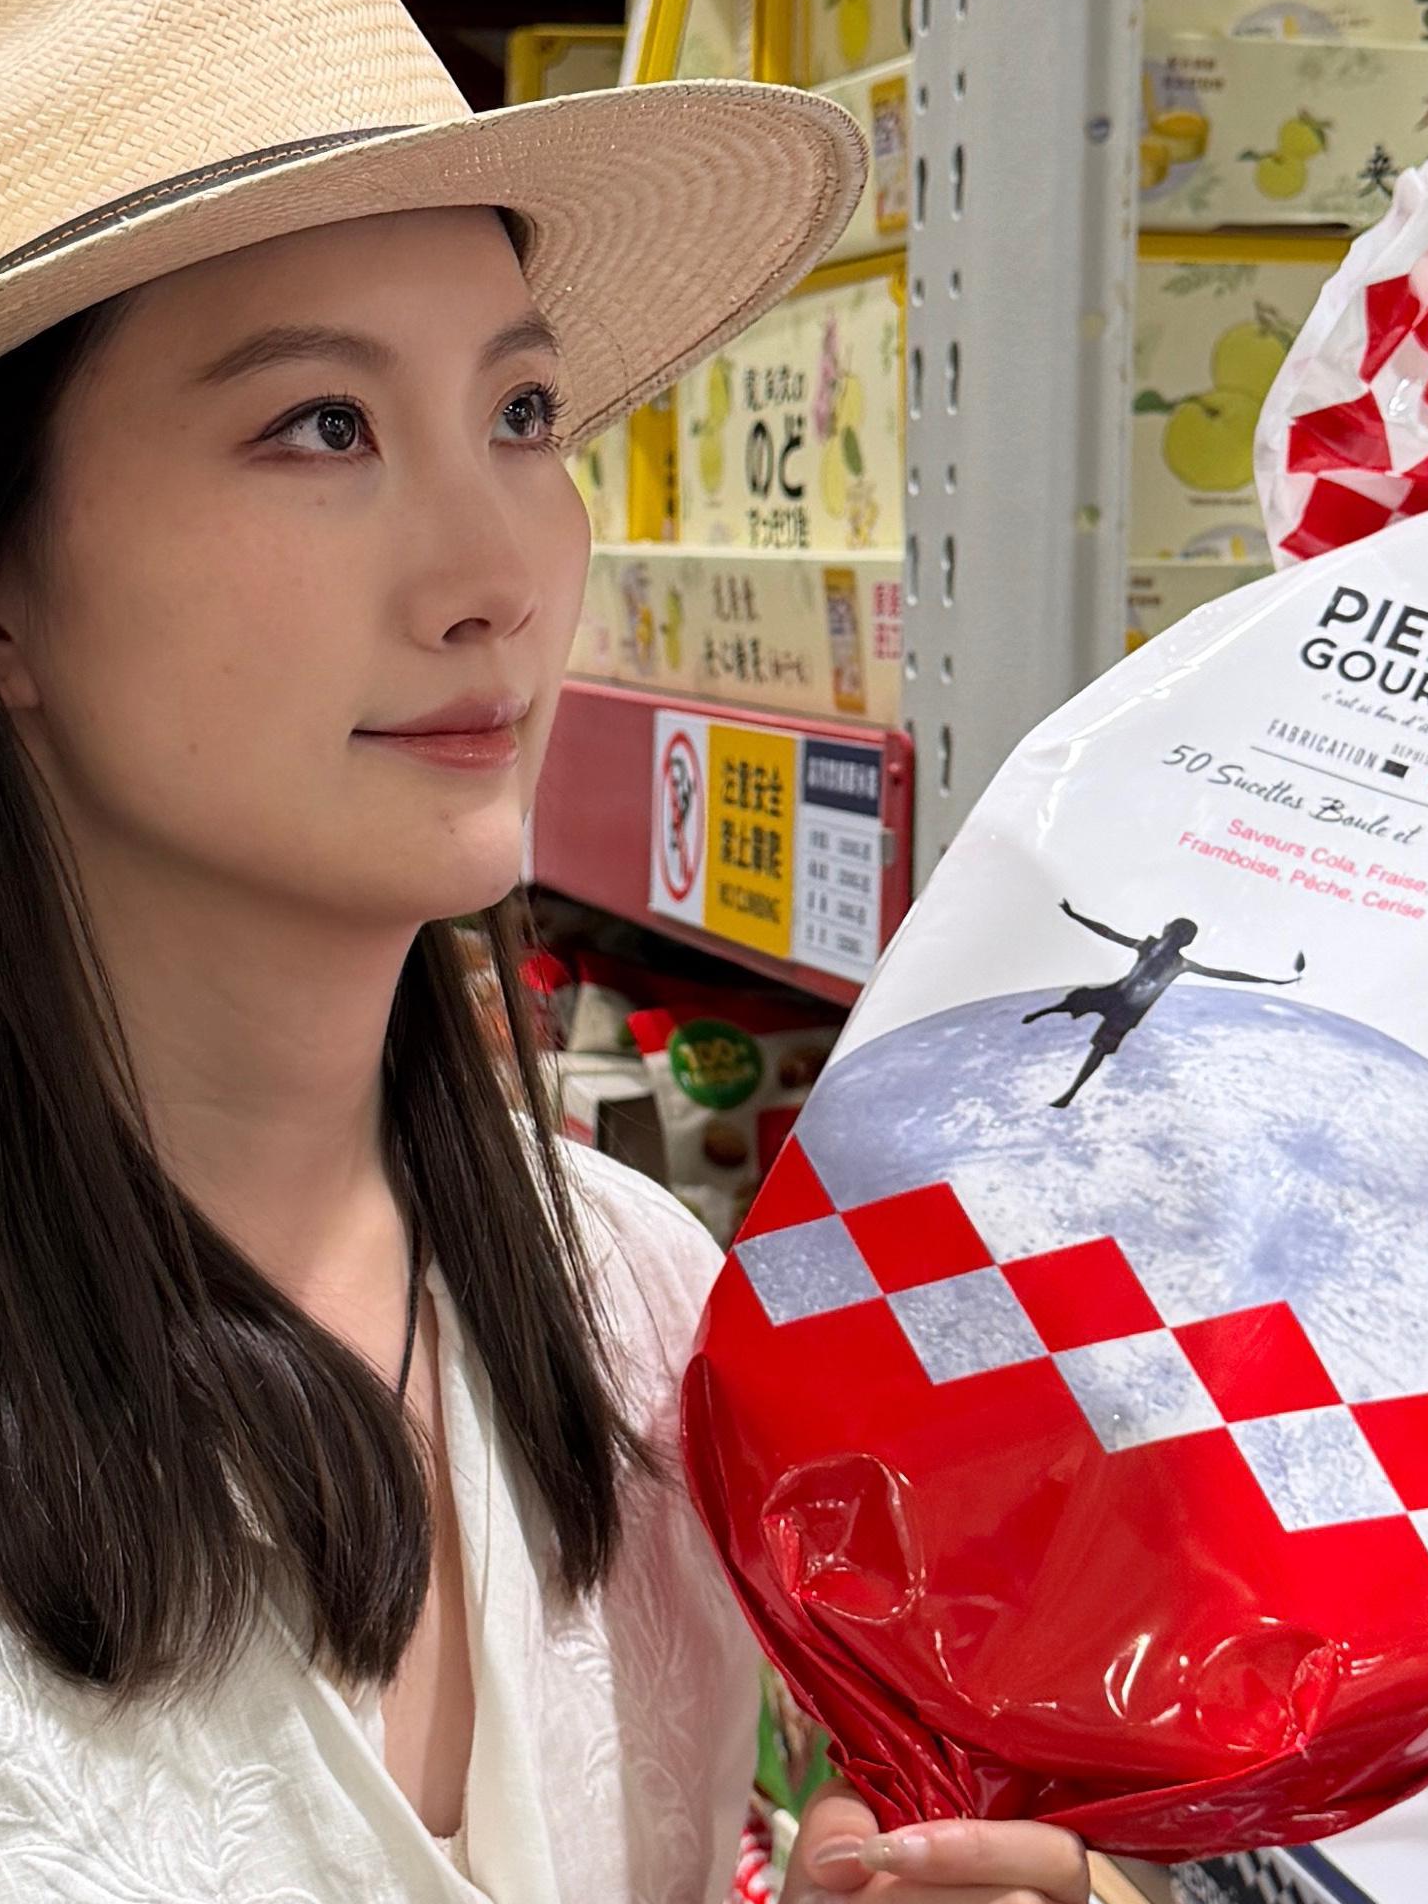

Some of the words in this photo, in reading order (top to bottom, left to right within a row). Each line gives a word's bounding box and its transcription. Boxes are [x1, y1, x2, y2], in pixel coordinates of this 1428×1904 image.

[745, 414, 805, 502] のど
[1266, 718, 1379, 770] FABRICATION
[1161, 744, 1213, 774] 50
[1207, 763, 1304, 810] Sucettes
[1308, 796, 1389, 839] Boule
[1394, 826, 1423, 846] et
[1178, 830, 1282, 883] Framboise,
[1361, 890, 1426, 920] Cerise
[1227, 817, 1307, 860] Saveurs
[1310, 846, 1360, 878] Cola,
